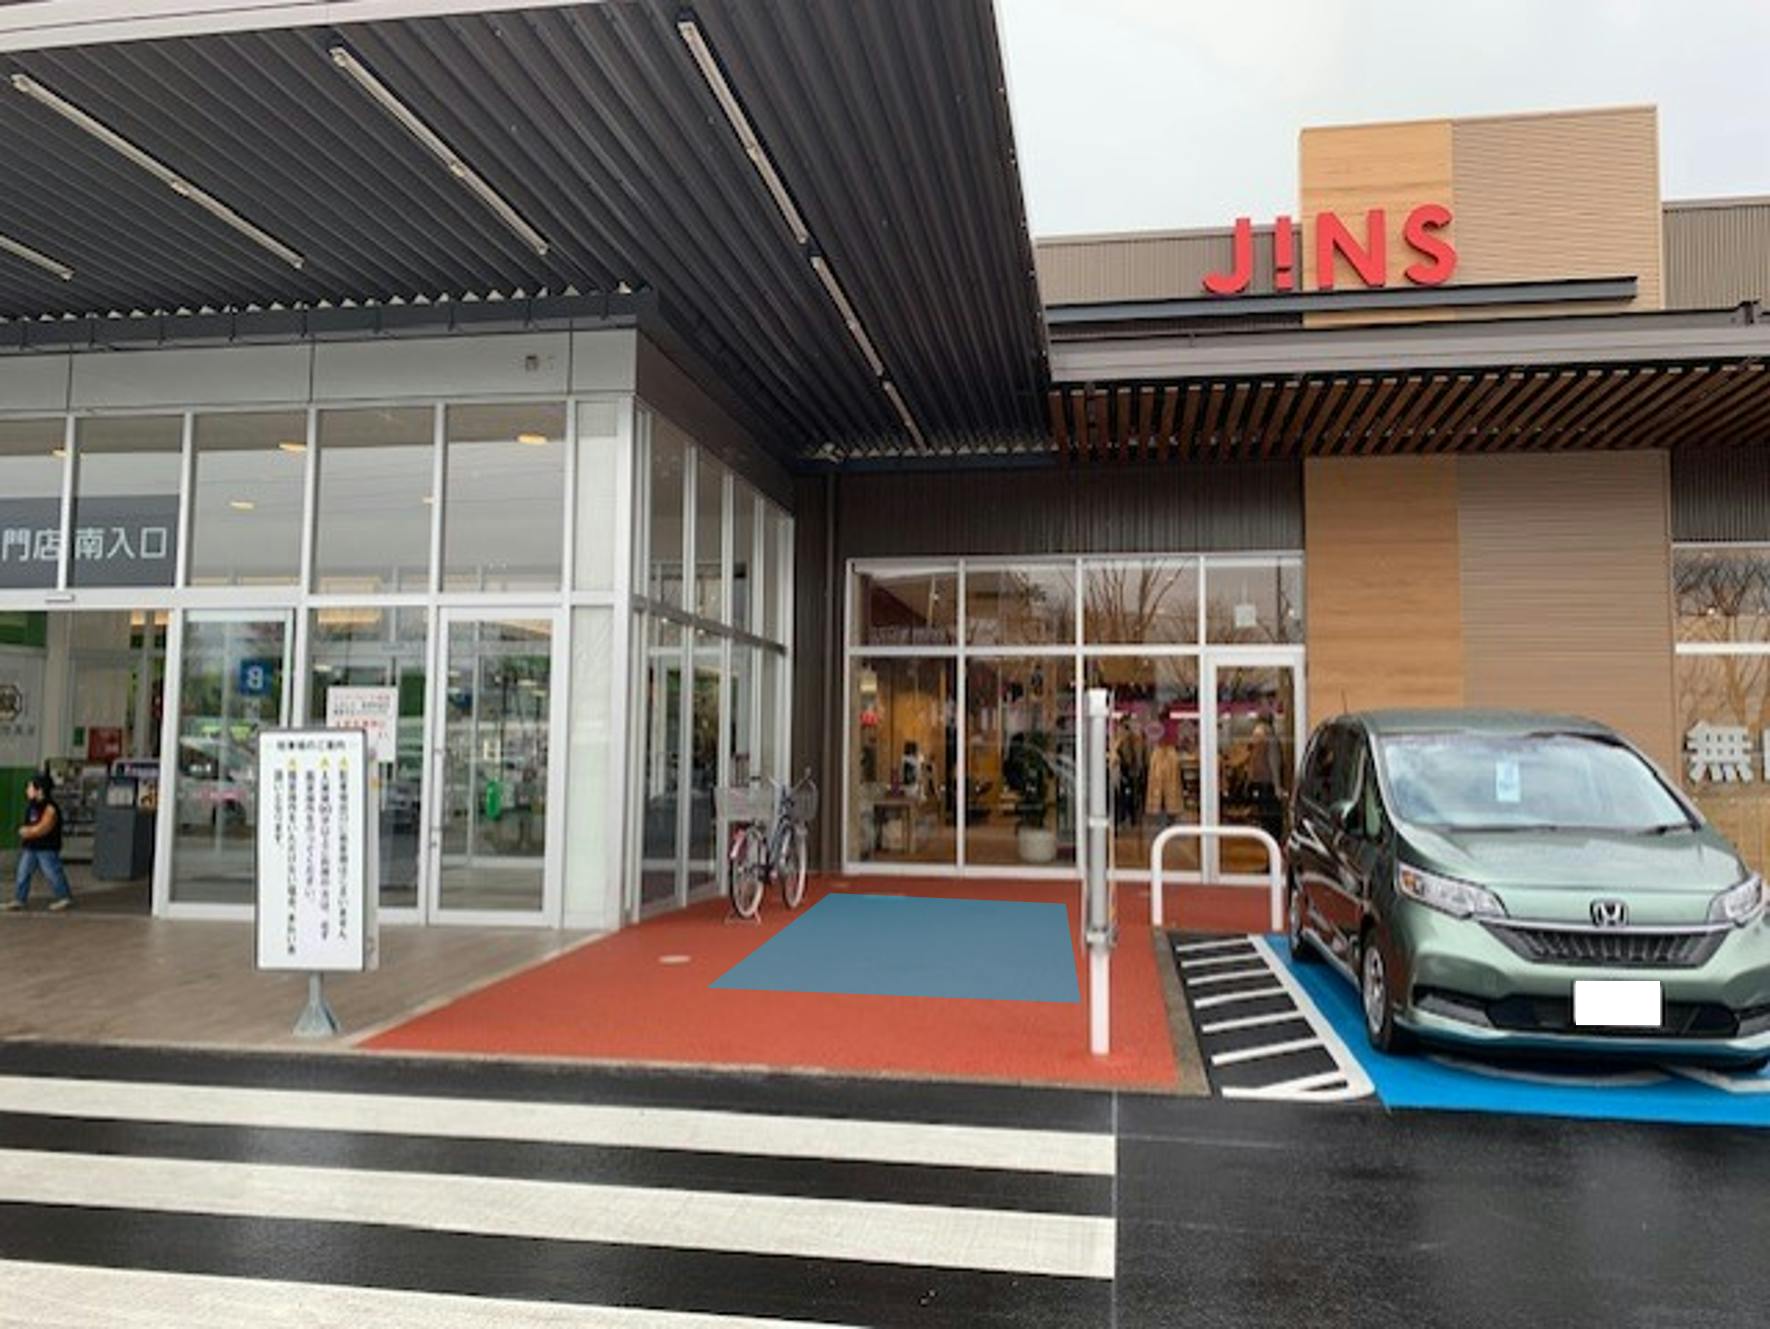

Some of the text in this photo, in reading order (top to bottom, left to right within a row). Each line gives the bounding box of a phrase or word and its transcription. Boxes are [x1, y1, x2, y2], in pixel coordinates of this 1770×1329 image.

[2, 527, 168, 562] 門店 南入口
[1686, 721, 1770, 783] 無
